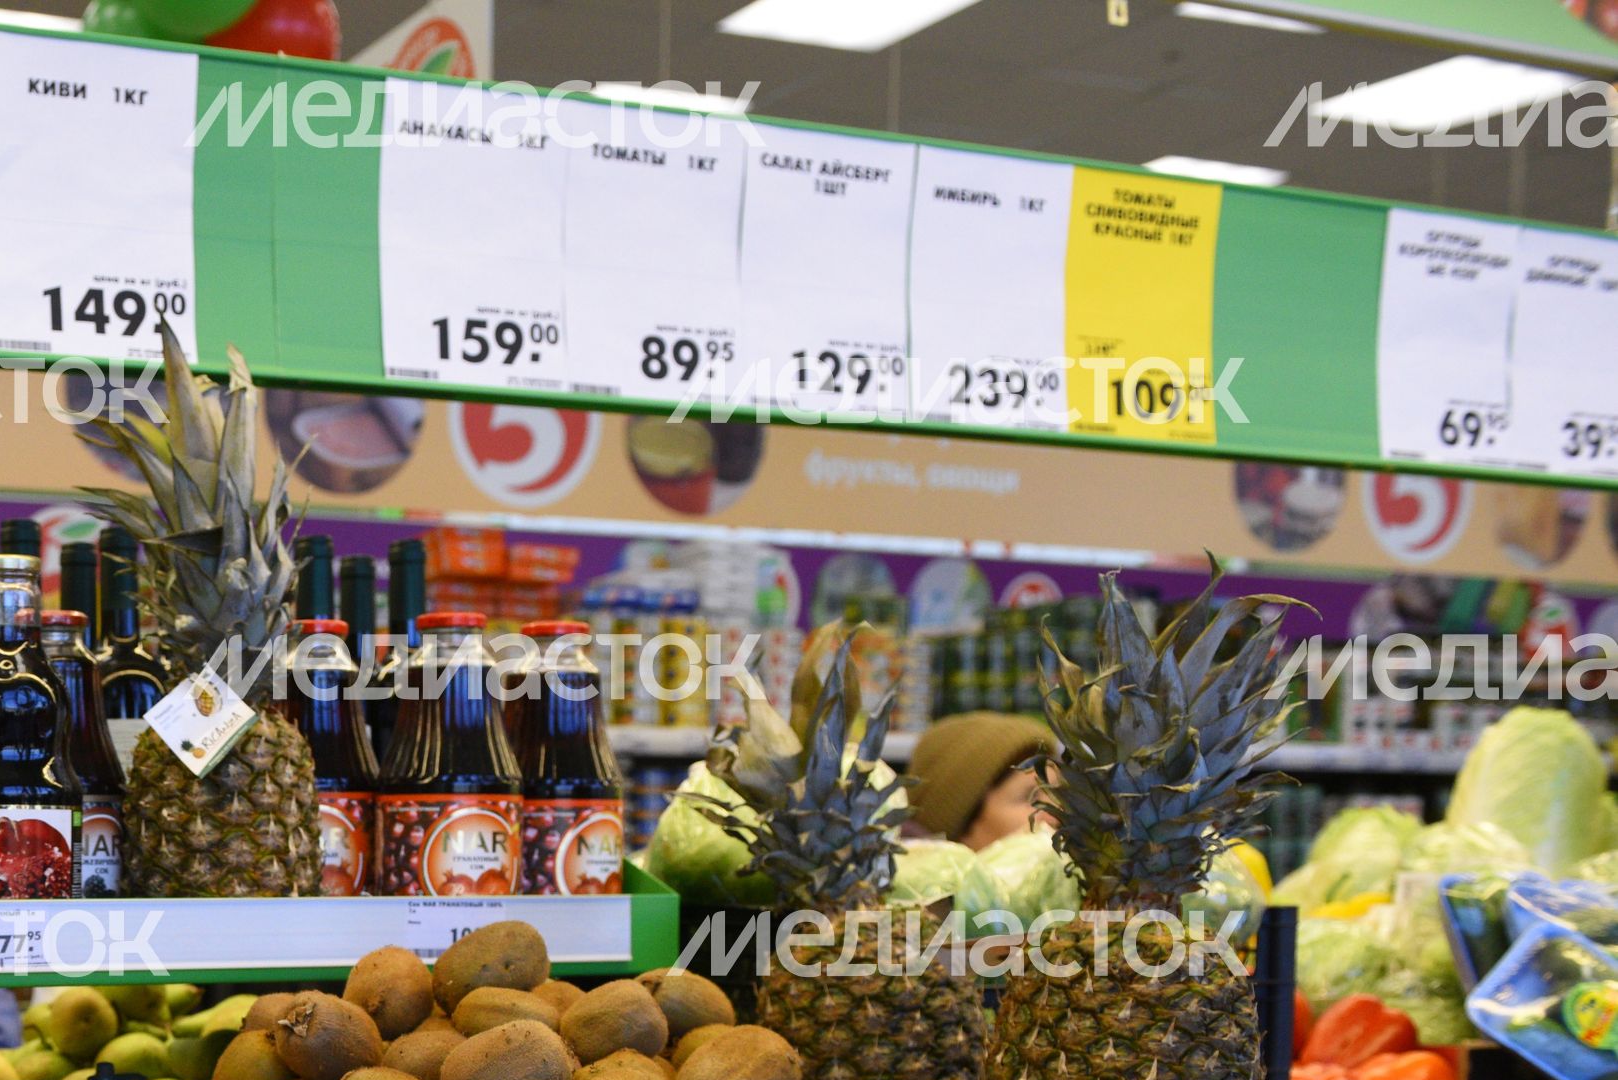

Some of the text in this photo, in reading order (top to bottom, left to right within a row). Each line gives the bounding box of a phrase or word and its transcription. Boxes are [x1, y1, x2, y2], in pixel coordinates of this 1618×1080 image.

[27, 78, 149, 105] КИВИ 1КГ
[397, 119, 493, 144] АНАНАСЫ
[591, 143, 719, 172] ТОМАТЫ 1КГ
[760, 151, 892, 184] САЛАТ АЙСБЕРГ
[813, 179, 848, 197] 1ШТ
[933, 186, 1002, 209] ИМБИРЬ
[1113, 188, 1176, 209] ТОМАТЫ
[1085, 203, 1200, 229] СЛИВОВИДНЫЕ
[1093, 222, 1164, 243] КРАСНЫЕ
[441, 830, 508, 854] NAR
